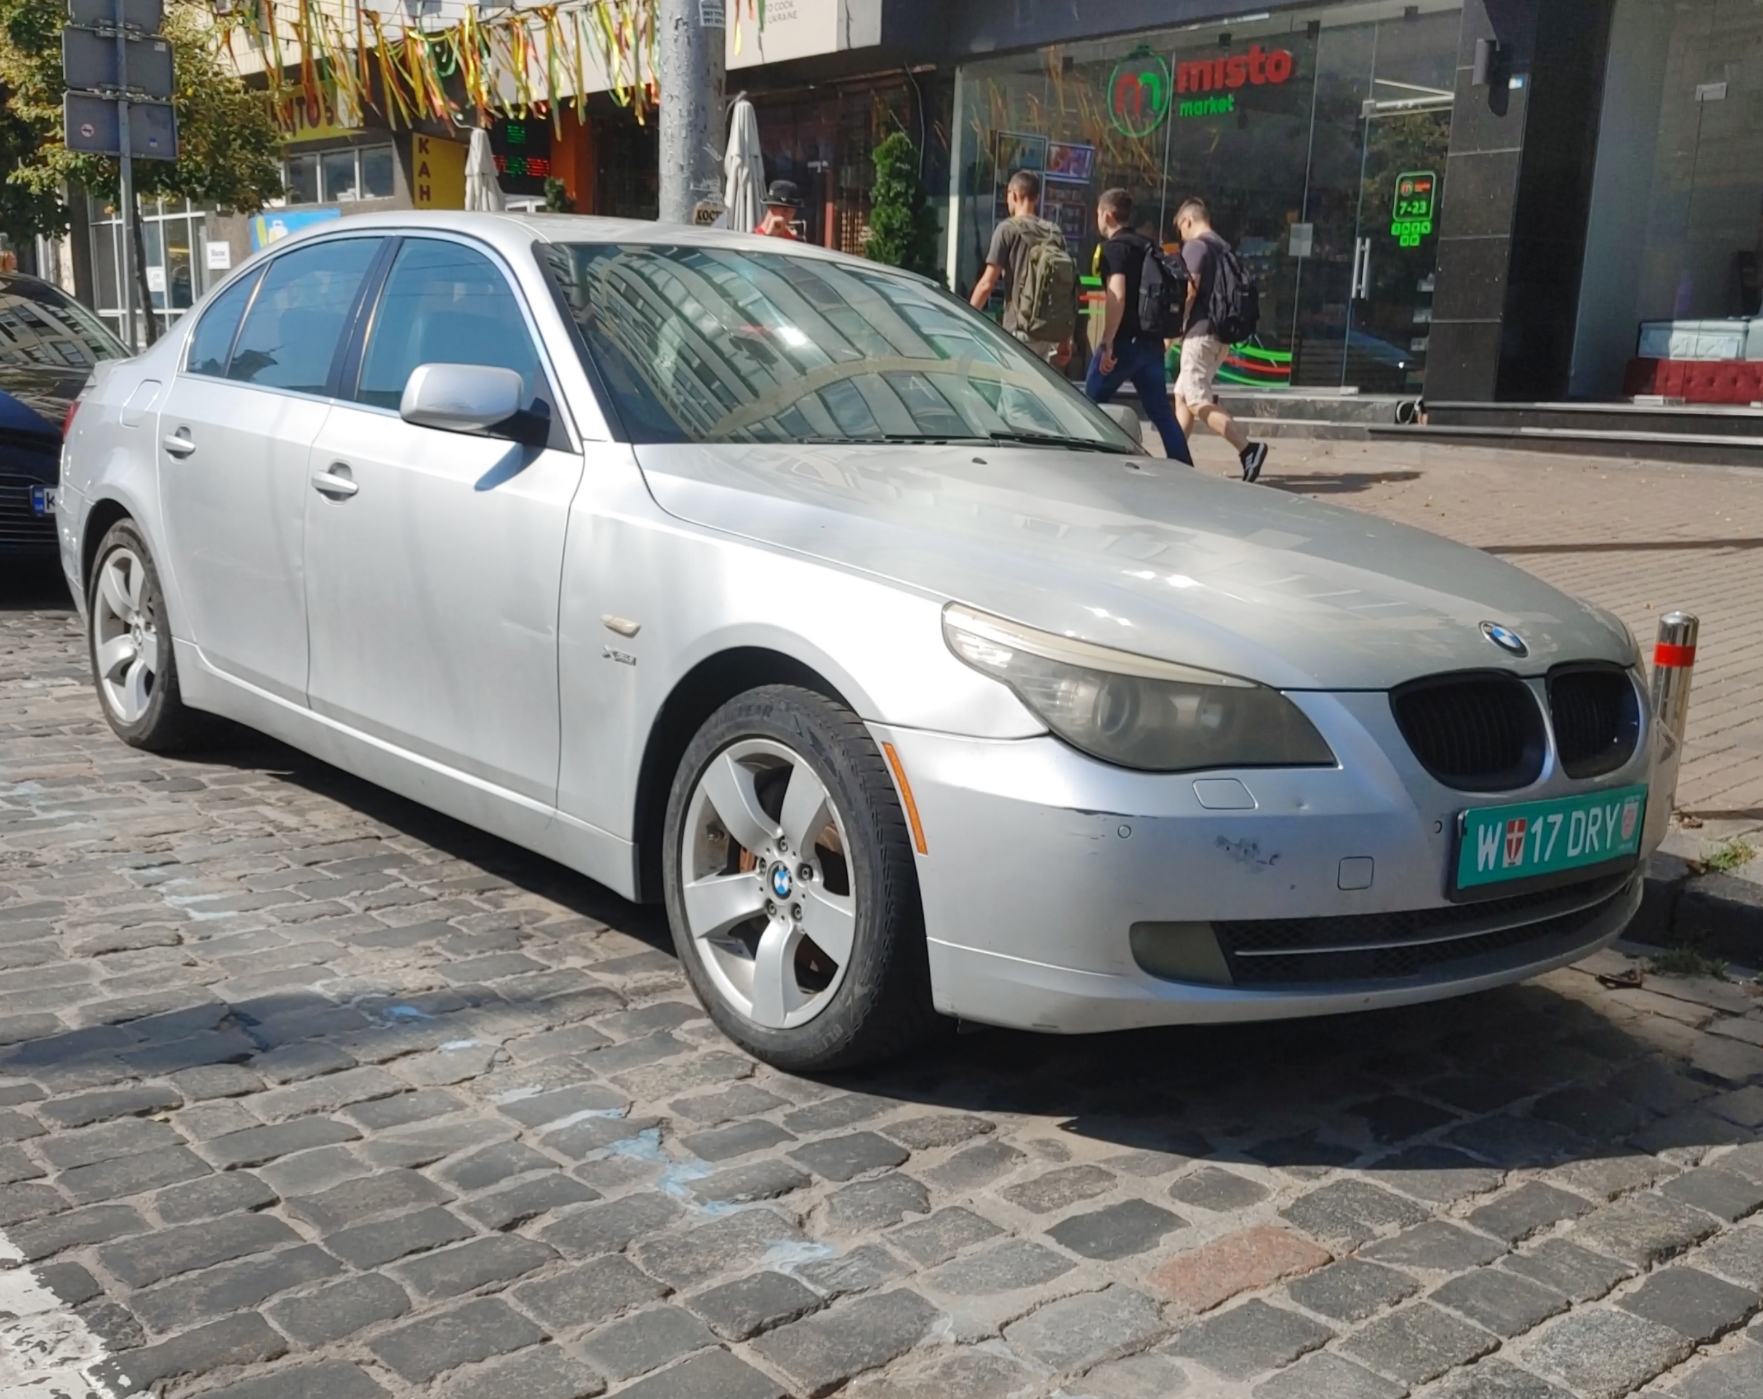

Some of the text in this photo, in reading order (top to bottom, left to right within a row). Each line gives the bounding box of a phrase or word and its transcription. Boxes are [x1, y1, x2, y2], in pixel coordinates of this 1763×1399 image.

[1176, 45, 1292, 93] misto
[1179, 93, 1234, 117] market
[1477, 802, 1621, 873] W 17 DRY
